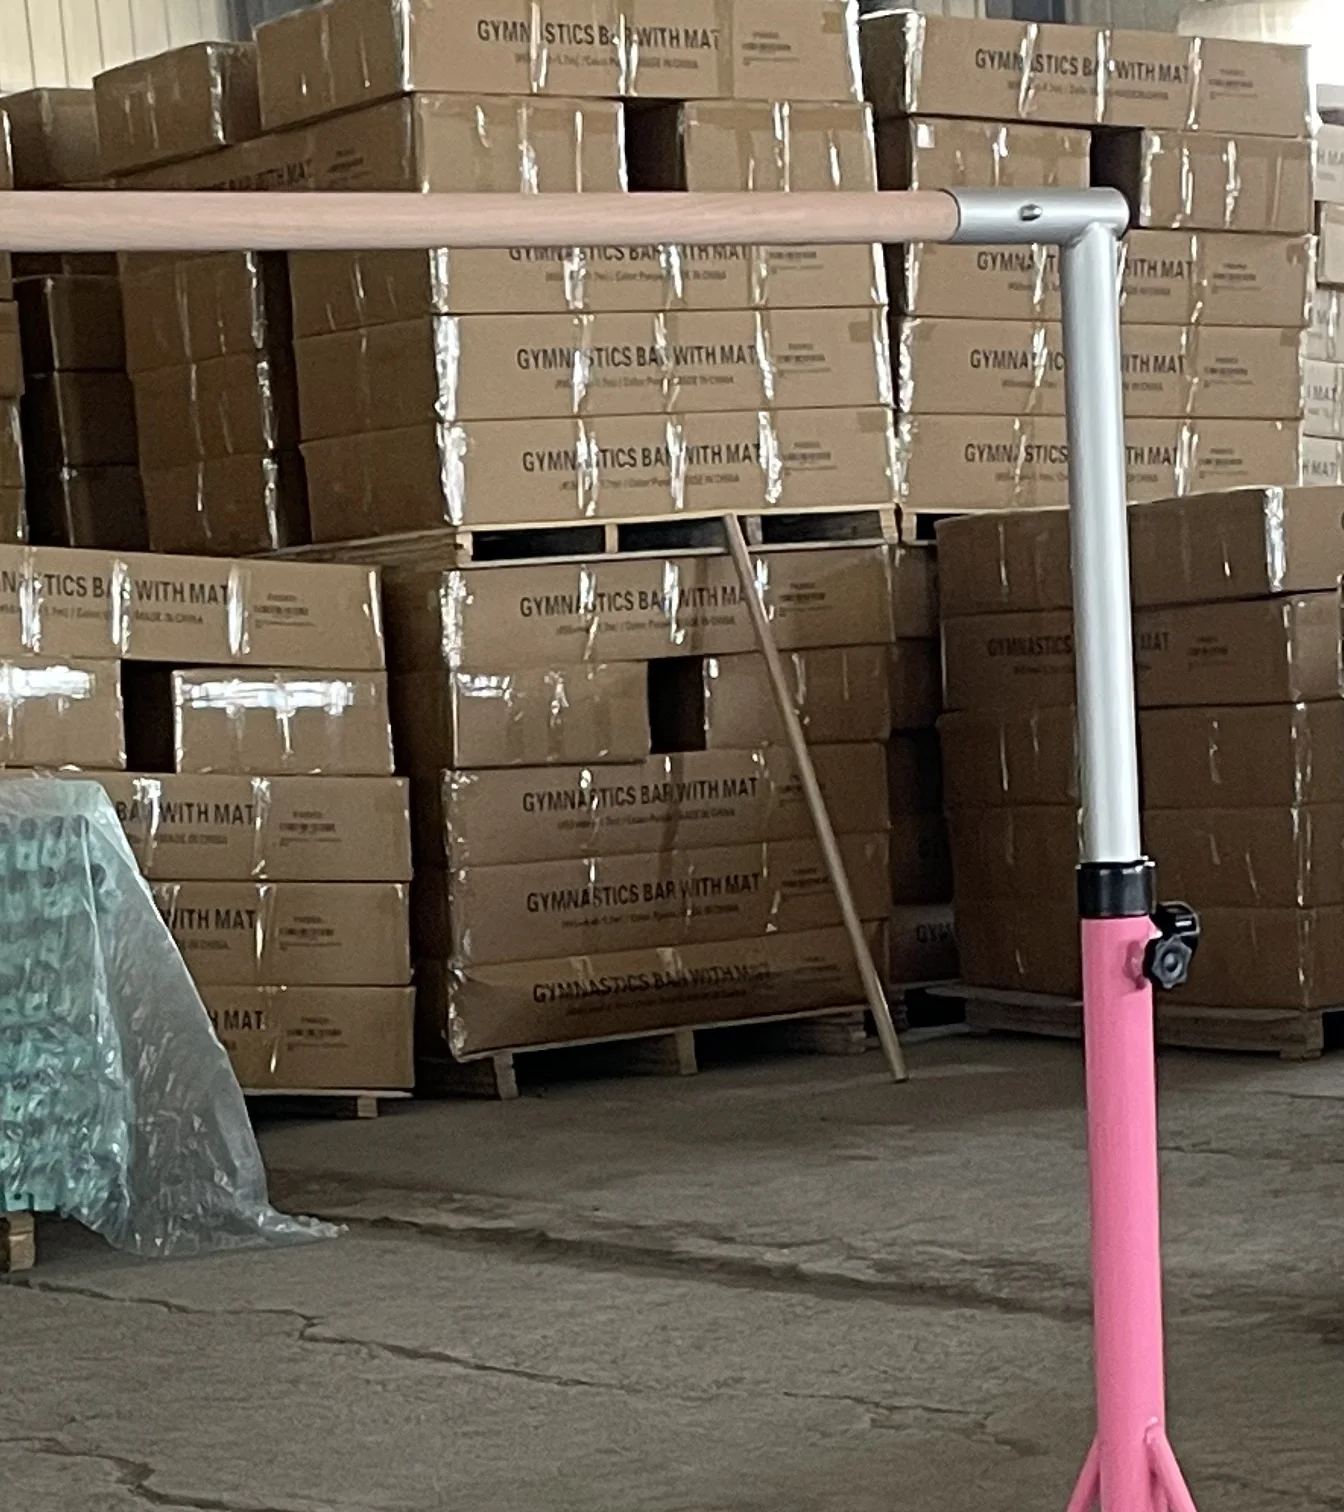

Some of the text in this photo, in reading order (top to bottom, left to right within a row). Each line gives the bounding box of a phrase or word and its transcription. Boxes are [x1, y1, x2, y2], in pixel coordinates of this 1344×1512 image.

[477, 19, 595, 46] GYMNSTICS
[684, 28, 721, 51] MAT
[1161, 259, 1194, 280] MAT
[516, 346, 631, 370] GYMNTICS
[635, 346, 668, 368] BA
[673, 346, 716, 367] WITH
[720, 345, 757, 366] MAT
[1122, 354, 1150, 374] ITH
[1153, 354, 1185, 375] MAT
[522, 446, 637, 473] GYMNTICS
[641, 446, 672, 468] BA
[134, 579, 185, 603] WITH
[190, 582, 229, 606] MAT
[638, 589, 668, 612] BA
[678, 586, 717, 609] WITH
[721, 586, 747, 606] MA
[640, 781, 673, 805] BAR
[676, 779, 719, 803] WITH
[723, 777, 758, 798] MAT
[158, 802, 209, 825] WITH
[214, 802, 254, 825] MAT
[526, 872, 761, 913] GYMNASTICS BAR WITH MAT
[215, 908, 256, 931] MAT
[223, 1010, 264, 1031] MAT
